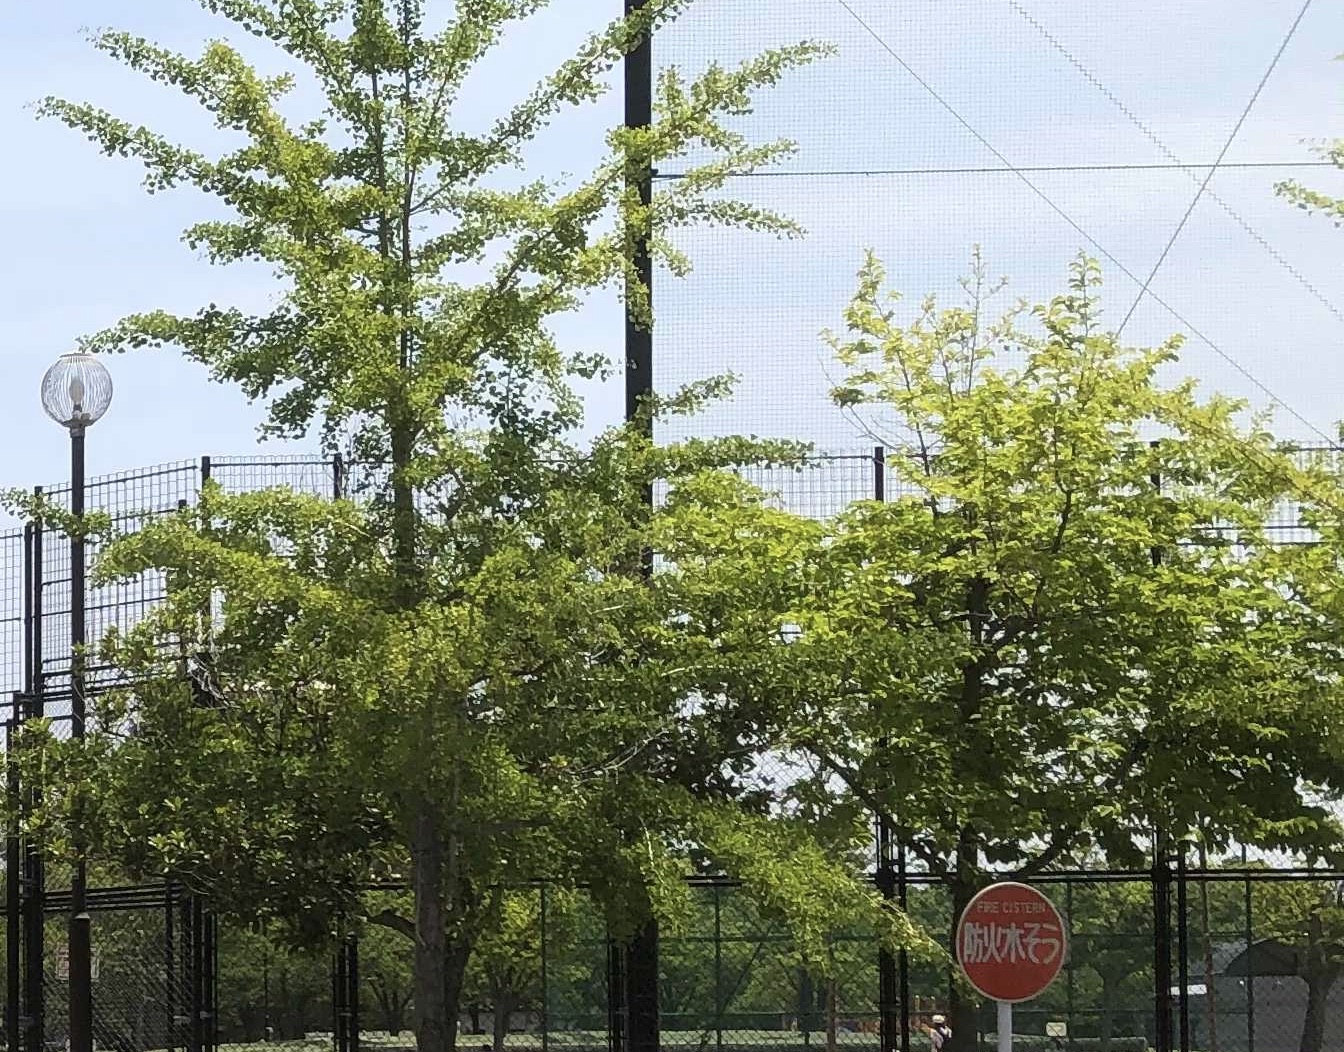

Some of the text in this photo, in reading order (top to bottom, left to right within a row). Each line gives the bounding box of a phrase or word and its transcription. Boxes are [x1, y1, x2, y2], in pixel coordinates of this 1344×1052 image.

[976, 901, 1045, 913] FIRE CISTERN
[964, 922, 1061, 964] 防火水そう
